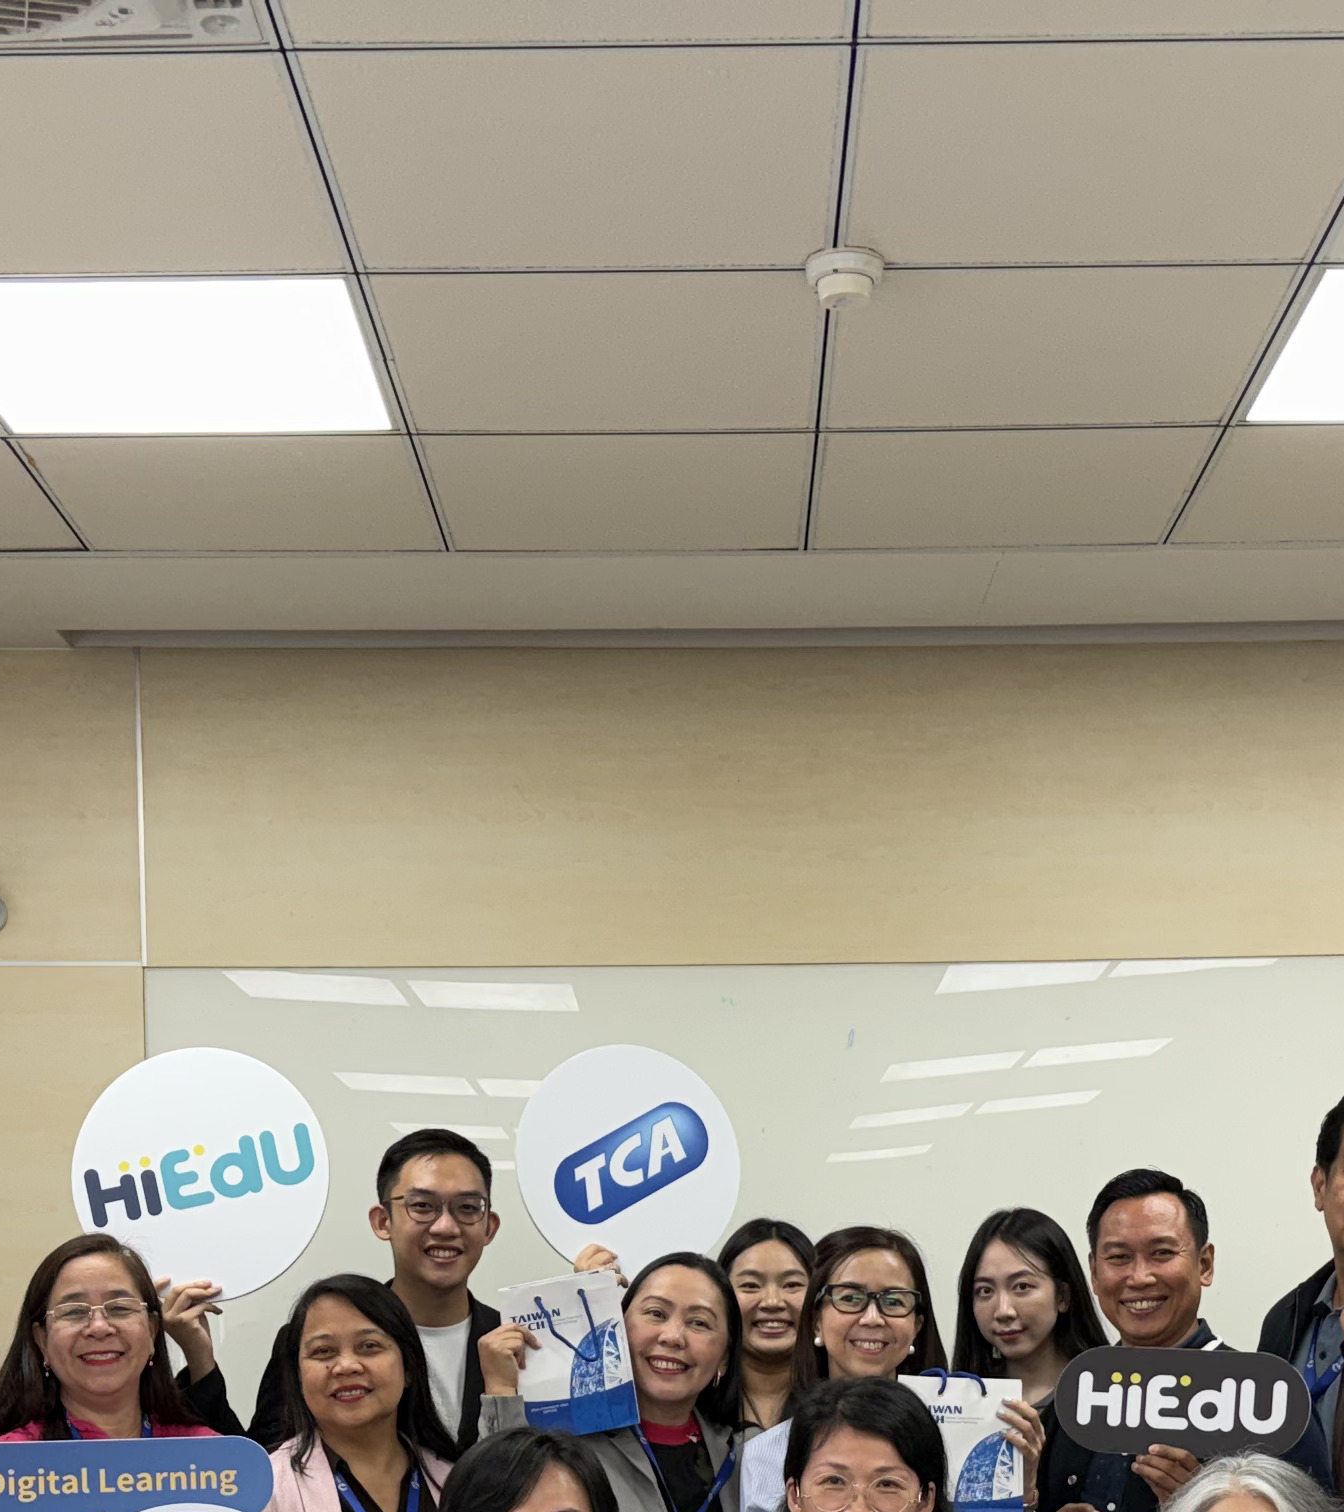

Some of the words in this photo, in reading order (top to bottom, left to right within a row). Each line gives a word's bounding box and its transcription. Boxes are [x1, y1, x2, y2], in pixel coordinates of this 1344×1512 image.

[84, 1122, 315, 1228] HiEdU
[574, 1114, 688, 1213] TCA
[1076, 1370, 1289, 1435] HiEdU
[98, 1463, 239, 1497] Learning
